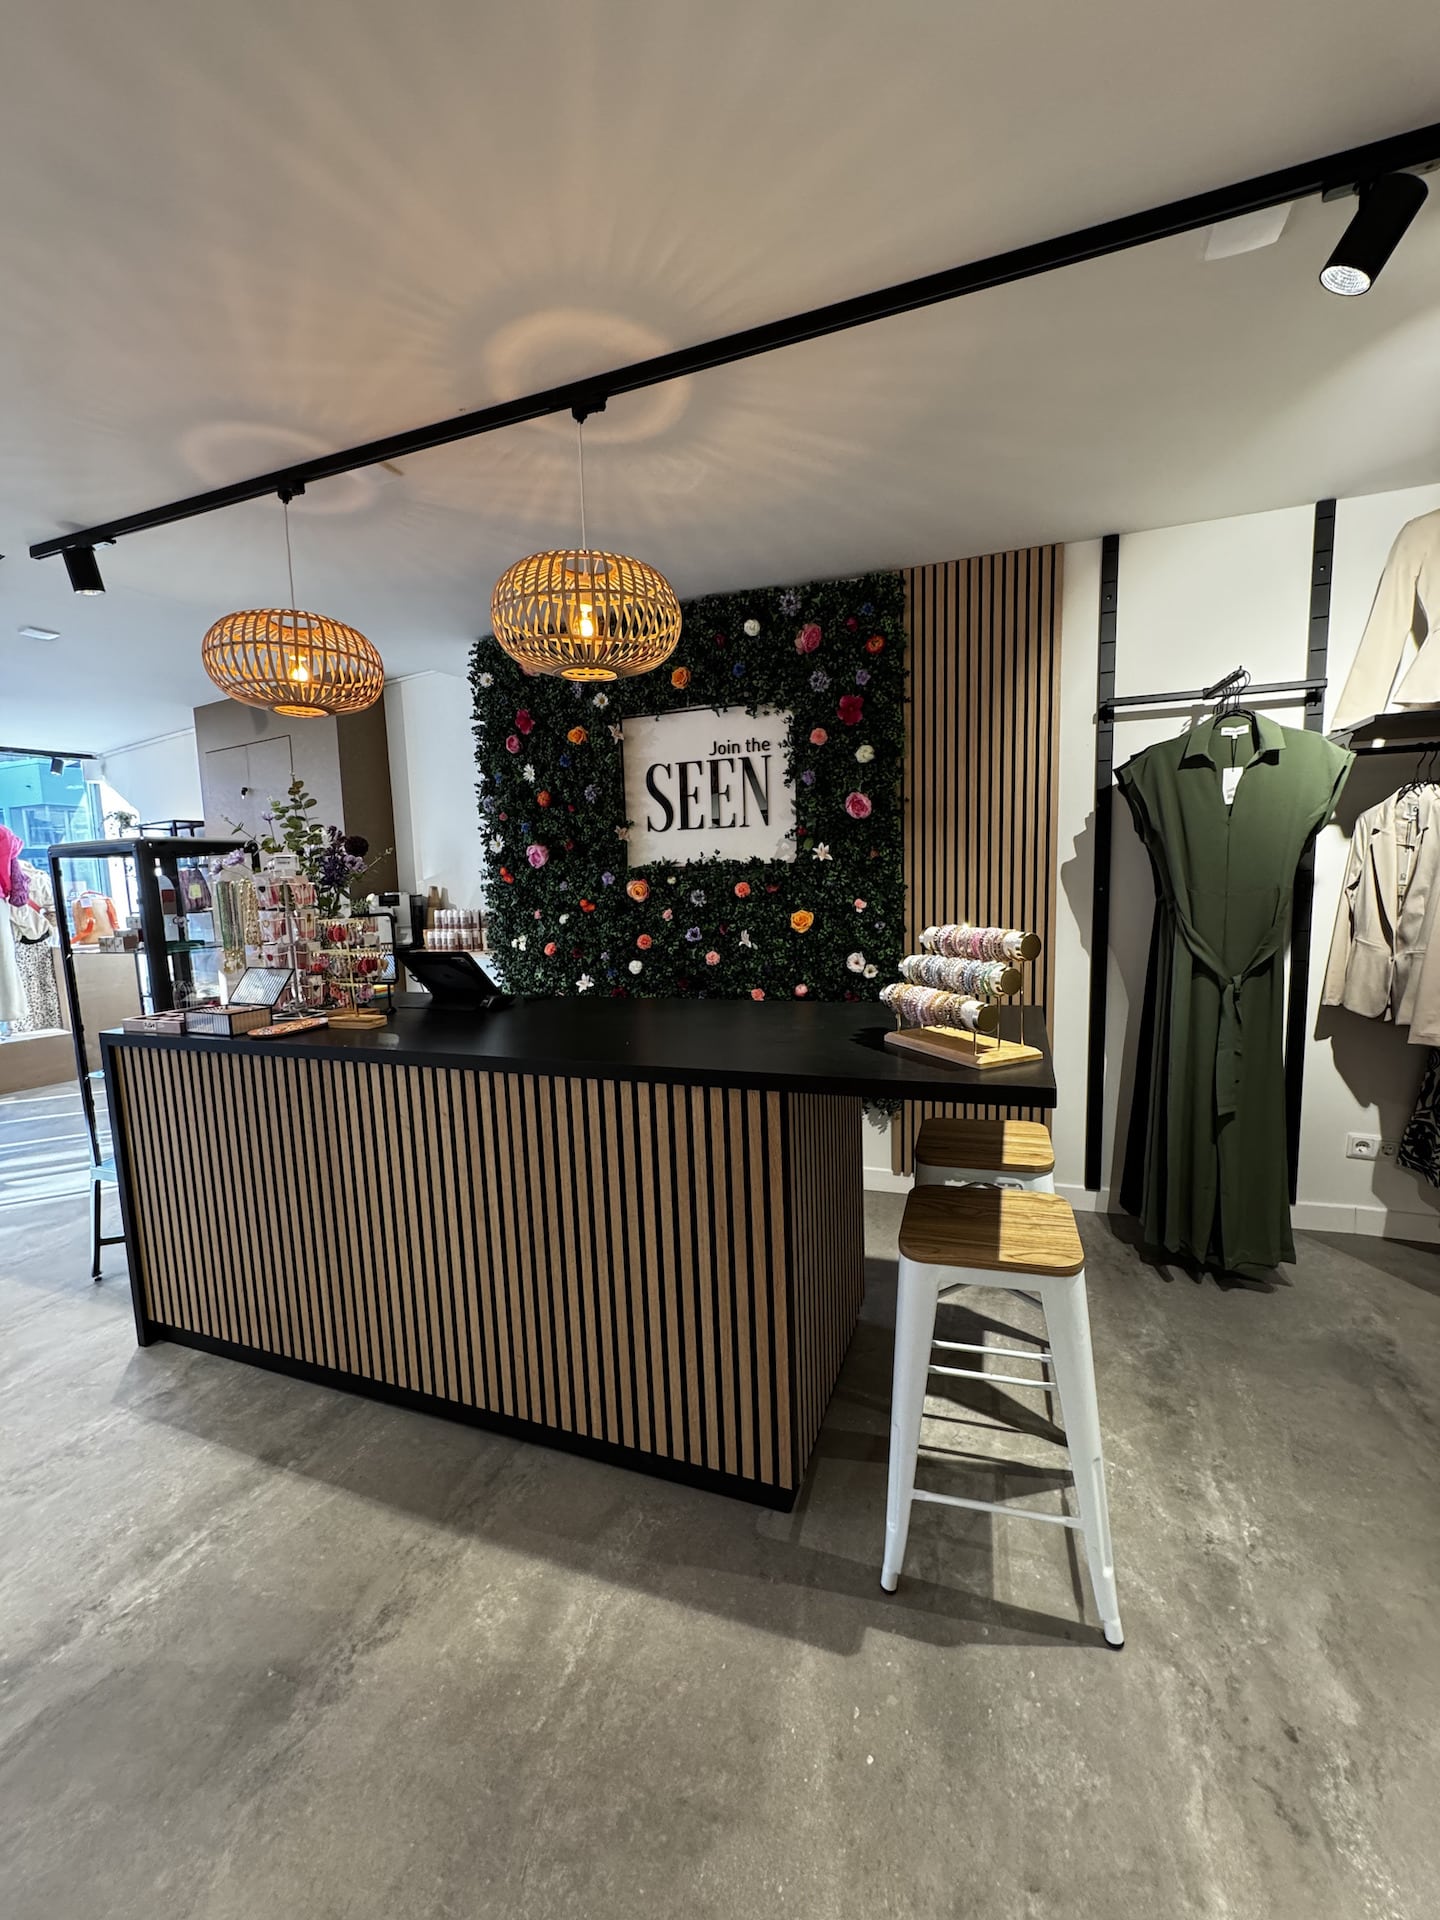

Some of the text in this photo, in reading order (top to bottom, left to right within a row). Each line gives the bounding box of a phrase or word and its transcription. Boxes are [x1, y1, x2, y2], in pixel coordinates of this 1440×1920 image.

[709, 737, 771, 755] Join the
[646, 755, 772, 832] SEEN
